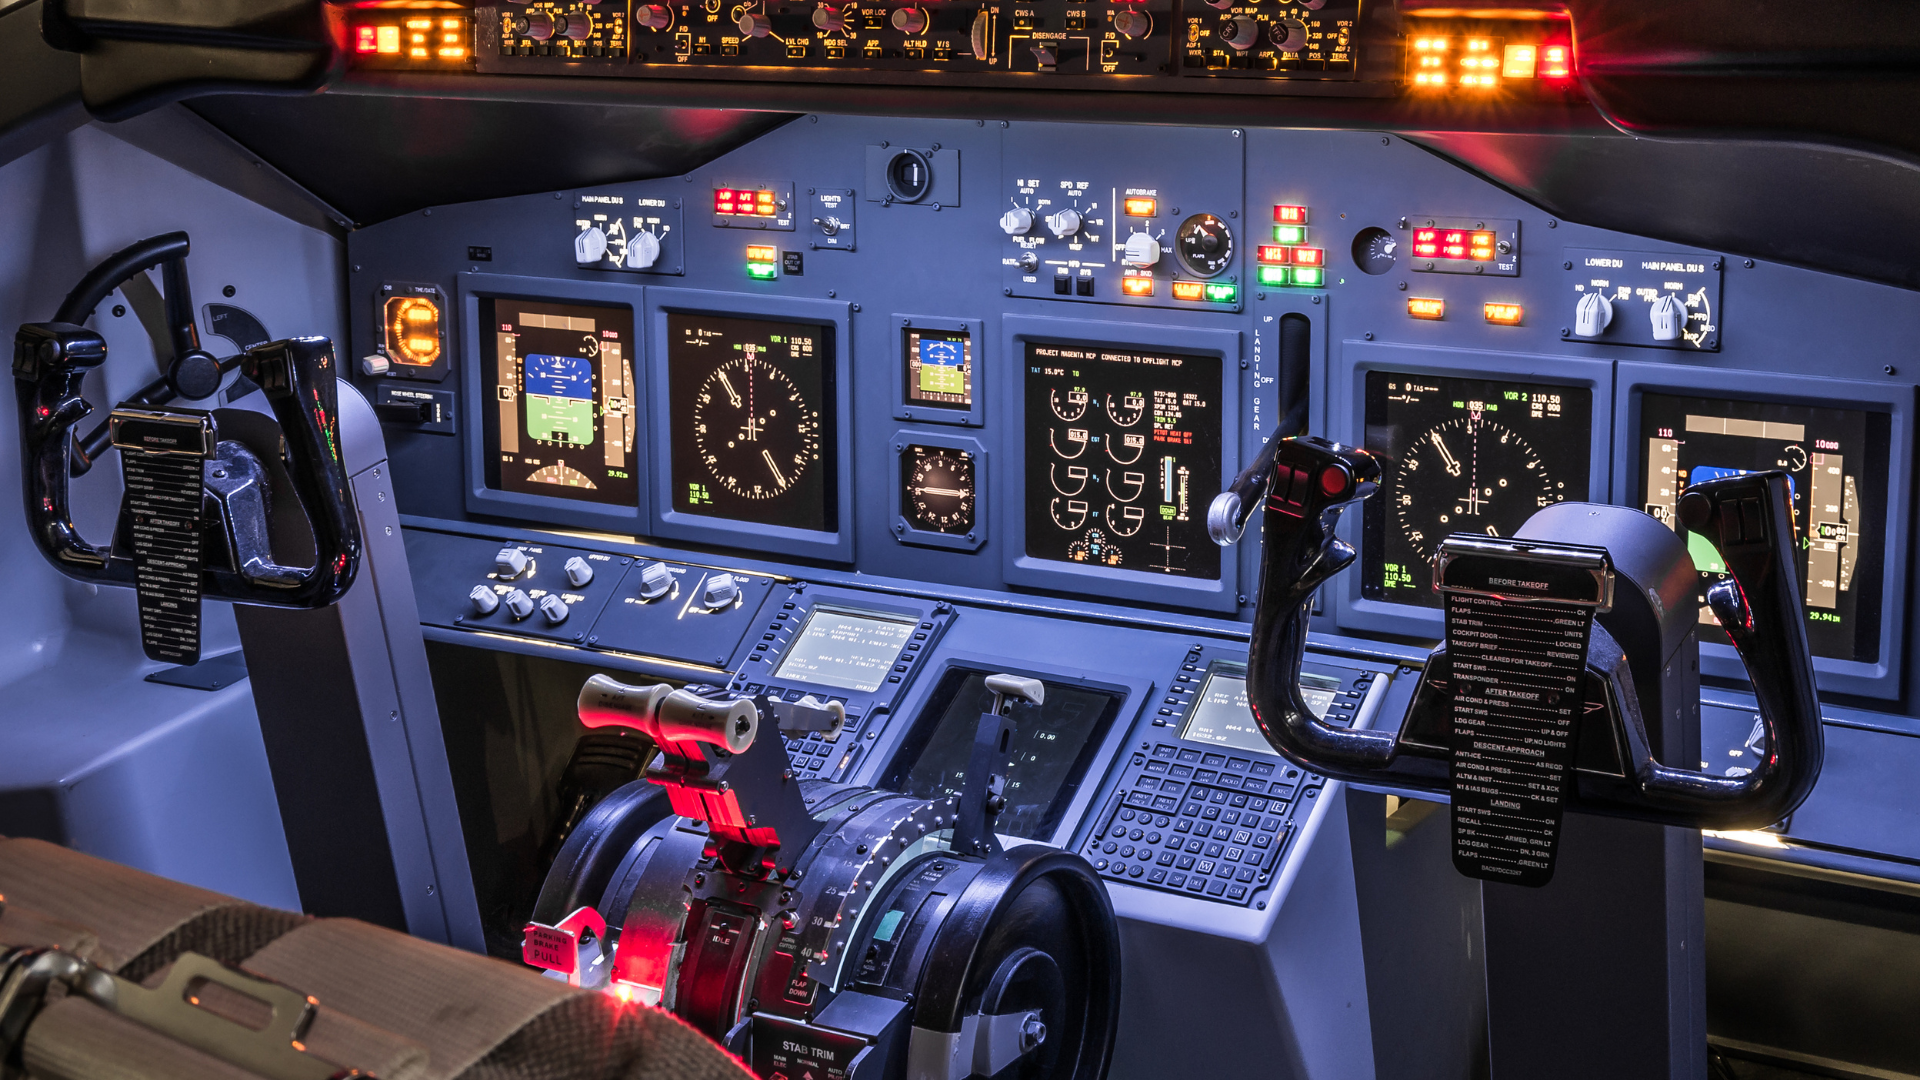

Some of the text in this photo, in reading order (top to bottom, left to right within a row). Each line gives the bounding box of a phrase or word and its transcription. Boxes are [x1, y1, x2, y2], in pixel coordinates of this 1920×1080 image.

[1222, 23, 1234, 37] CRT
[1272, 25, 1283, 41] TFC
[1126, 188, 1157, 196] AUTOBRAKE
[1585, 258, 1623, 268] LOWER DU
[1642, 262, 1697, 272] MAIN PANEL DU
[213, 313, 228, 321] LEFT
[1036, 348, 1059, 356] PROJECT
[1061, 350, 1084, 358] MAGENTA
[1101, 353, 1131, 362] CONNECTED
[1143, 356, 1169, 365] CPFLIGHT
[1504, 391, 1528, 401] VOR 2
[1532, 394, 1560, 403] 110.50
[1658, 428, 1672, 437] 110
[1384, 563, 1398, 572] VOR
[1384, 572, 1411, 582] 110.50
[1489, 578, 1549, 590] BEFORE TAKEOFF
[1474, 599, 1503, 607] CONTROL
[1810, 612, 1832, 621] 29.94
[1452, 629, 1479, 637] COCKPIT
[1555, 641, 1581, 649] LOCKED
[1451, 640, 1479, 648] TAKEOFF
[1546, 651, 1579, 660] REVIEWED
[1453, 662, 1472, 670] START
[1481, 654, 1510, 663] CLEARED
[1525, 659, 1553, 668] TAKEOFF
[1453, 673, 1498, 684] TRANSPONDER
[1485, 688, 1540, 700] AFTER TAKEOFF
[1454, 706, 1473, 714] START
[1474, 742, 1545, 757] DESCENT-APPROACH
[1490, 799, 1520, 809] LANDING
[1458, 817, 1481, 825] RECALL
[1458, 850, 1478, 858] FLAPS
[825, 886, 837, 895] 25
[812, 916, 823, 926] 30
[534, 931, 567, 944] PARKING
[712, 935, 731, 945] IDLE
[534, 939, 558, 951] BRAKE
[534, 949, 562, 965] PULL
[801, 947, 812, 957] 40
[789, 988, 807, 997] DOWN
[783, 1041, 834, 1061] STAB TRIM
[797, 1058, 819, 1068] NORMAL
